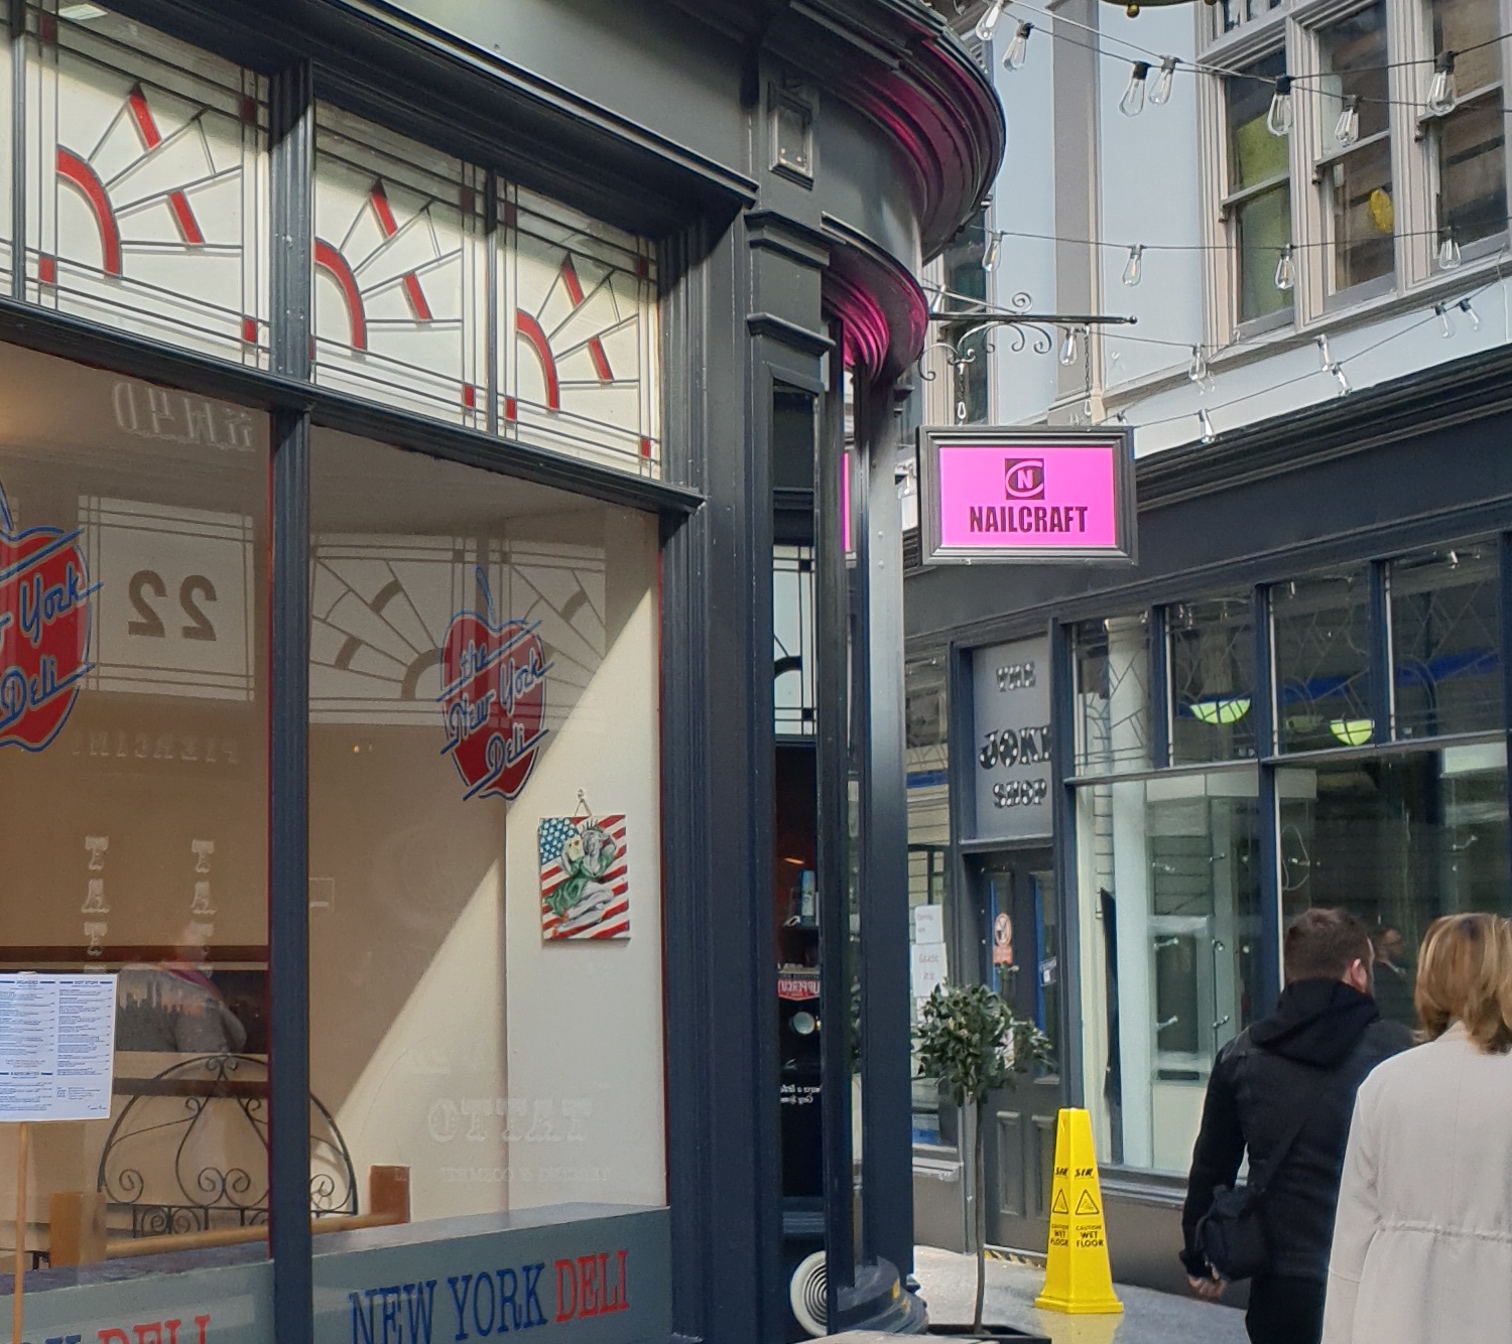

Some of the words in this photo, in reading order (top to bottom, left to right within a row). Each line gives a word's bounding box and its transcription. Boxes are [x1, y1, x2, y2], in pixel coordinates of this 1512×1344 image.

[968, 505, 1088, 533] NAILCRAFT
[20, 562, 90, 644] York
[500, 647, 544, 714] York
[993, 777, 1047, 809] SHOP
[1076, 1239, 1104, 1248] FLOOR
[447, 1262, 548, 1342] YORK
[554, 1250, 630, 1324] DELI
